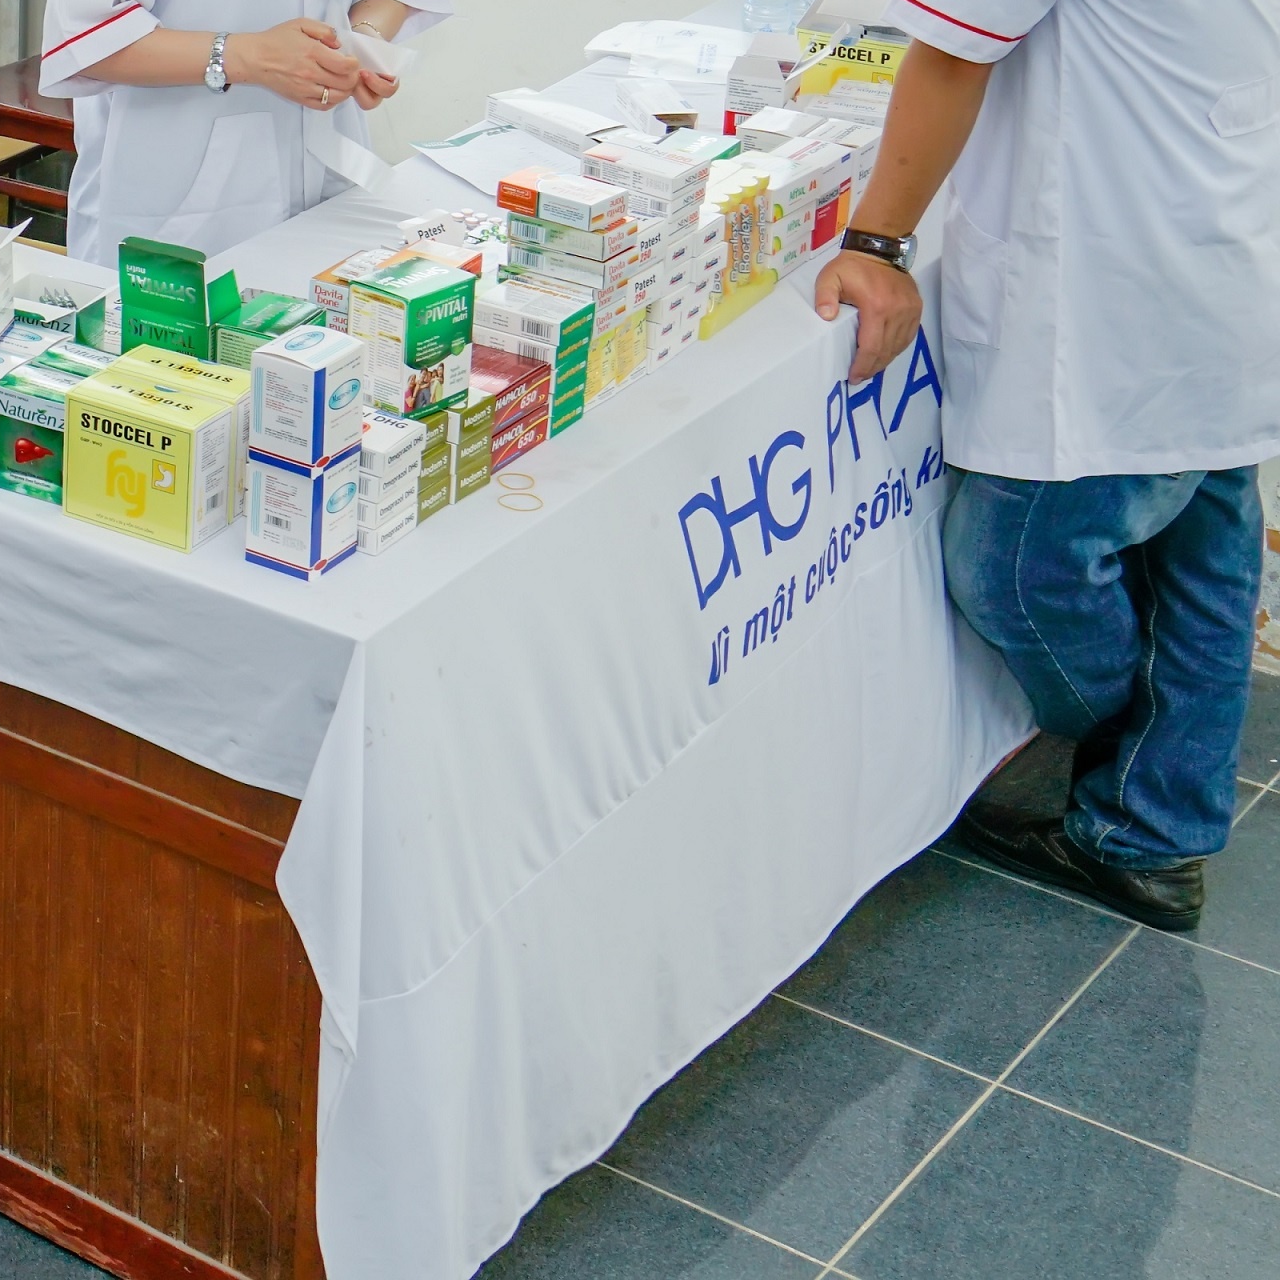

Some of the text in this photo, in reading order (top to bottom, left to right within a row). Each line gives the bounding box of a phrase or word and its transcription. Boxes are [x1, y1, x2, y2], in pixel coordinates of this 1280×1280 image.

[881, 53, 890, 64] P
[418, 224, 446, 240] Patest
[608, 231, 624, 246] Davita
[640, 233, 661, 251] Patest
[740, 209, 752, 274] Bocalex
[640, 249, 651, 263] 250
[608, 262, 626, 275] Davita
[315, 285, 343, 300] Davita
[598, 285, 614, 300] Davita
[635, 274, 656, 293] Patest
[317, 295, 340, 308] bone
[634, 291, 646, 304] 250
[415, 296, 468, 329] SPIVITAL
[452, 313, 468, 324] nutri
[596, 308, 613, 324] Davita
[14, 316, 71, 333] aturenz
[128, 318, 196, 349] SPIVITAL
[495, 384, 527, 411] HAPACOL
[520, 391, 537, 409] 650
[373, 416, 408, 429] DHG
[465, 406, 491, 427] Modom'S
[81, 413, 172, 450] STOCCEL P
[426, 424, 444, 441] dom'S
[492, 423, 535, 452] HAPACOL 650
[388, 445, 412, 465] Omeprazol
[461, 436, 488, 458] Modom'S
[678, 324, 942, 611] DHG PHA
[461, 466, 488, 488] Modom'S
[421, 487, 446, 510] Modom'S
[743, 576, 795, 658] một
[805, 524, 851, 604] cuộc
[854, 468, 912, 541] sống
